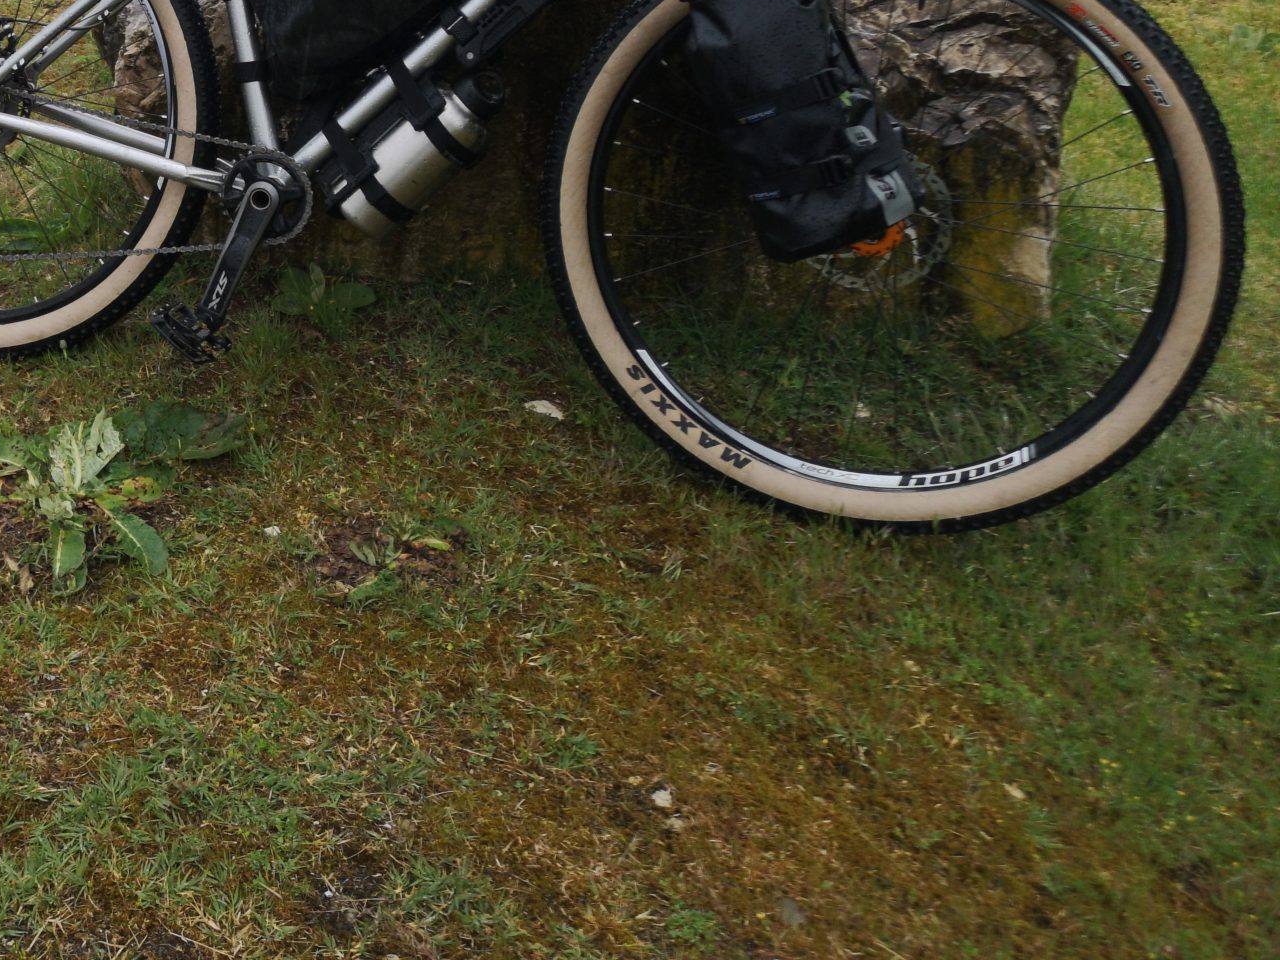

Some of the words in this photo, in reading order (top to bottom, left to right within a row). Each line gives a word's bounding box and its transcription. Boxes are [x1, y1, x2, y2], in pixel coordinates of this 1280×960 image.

[625, 364, 753, 470] MAXXIS
[799, 461, 834, 477] tech
[898, 455, 1015, 487] hope
